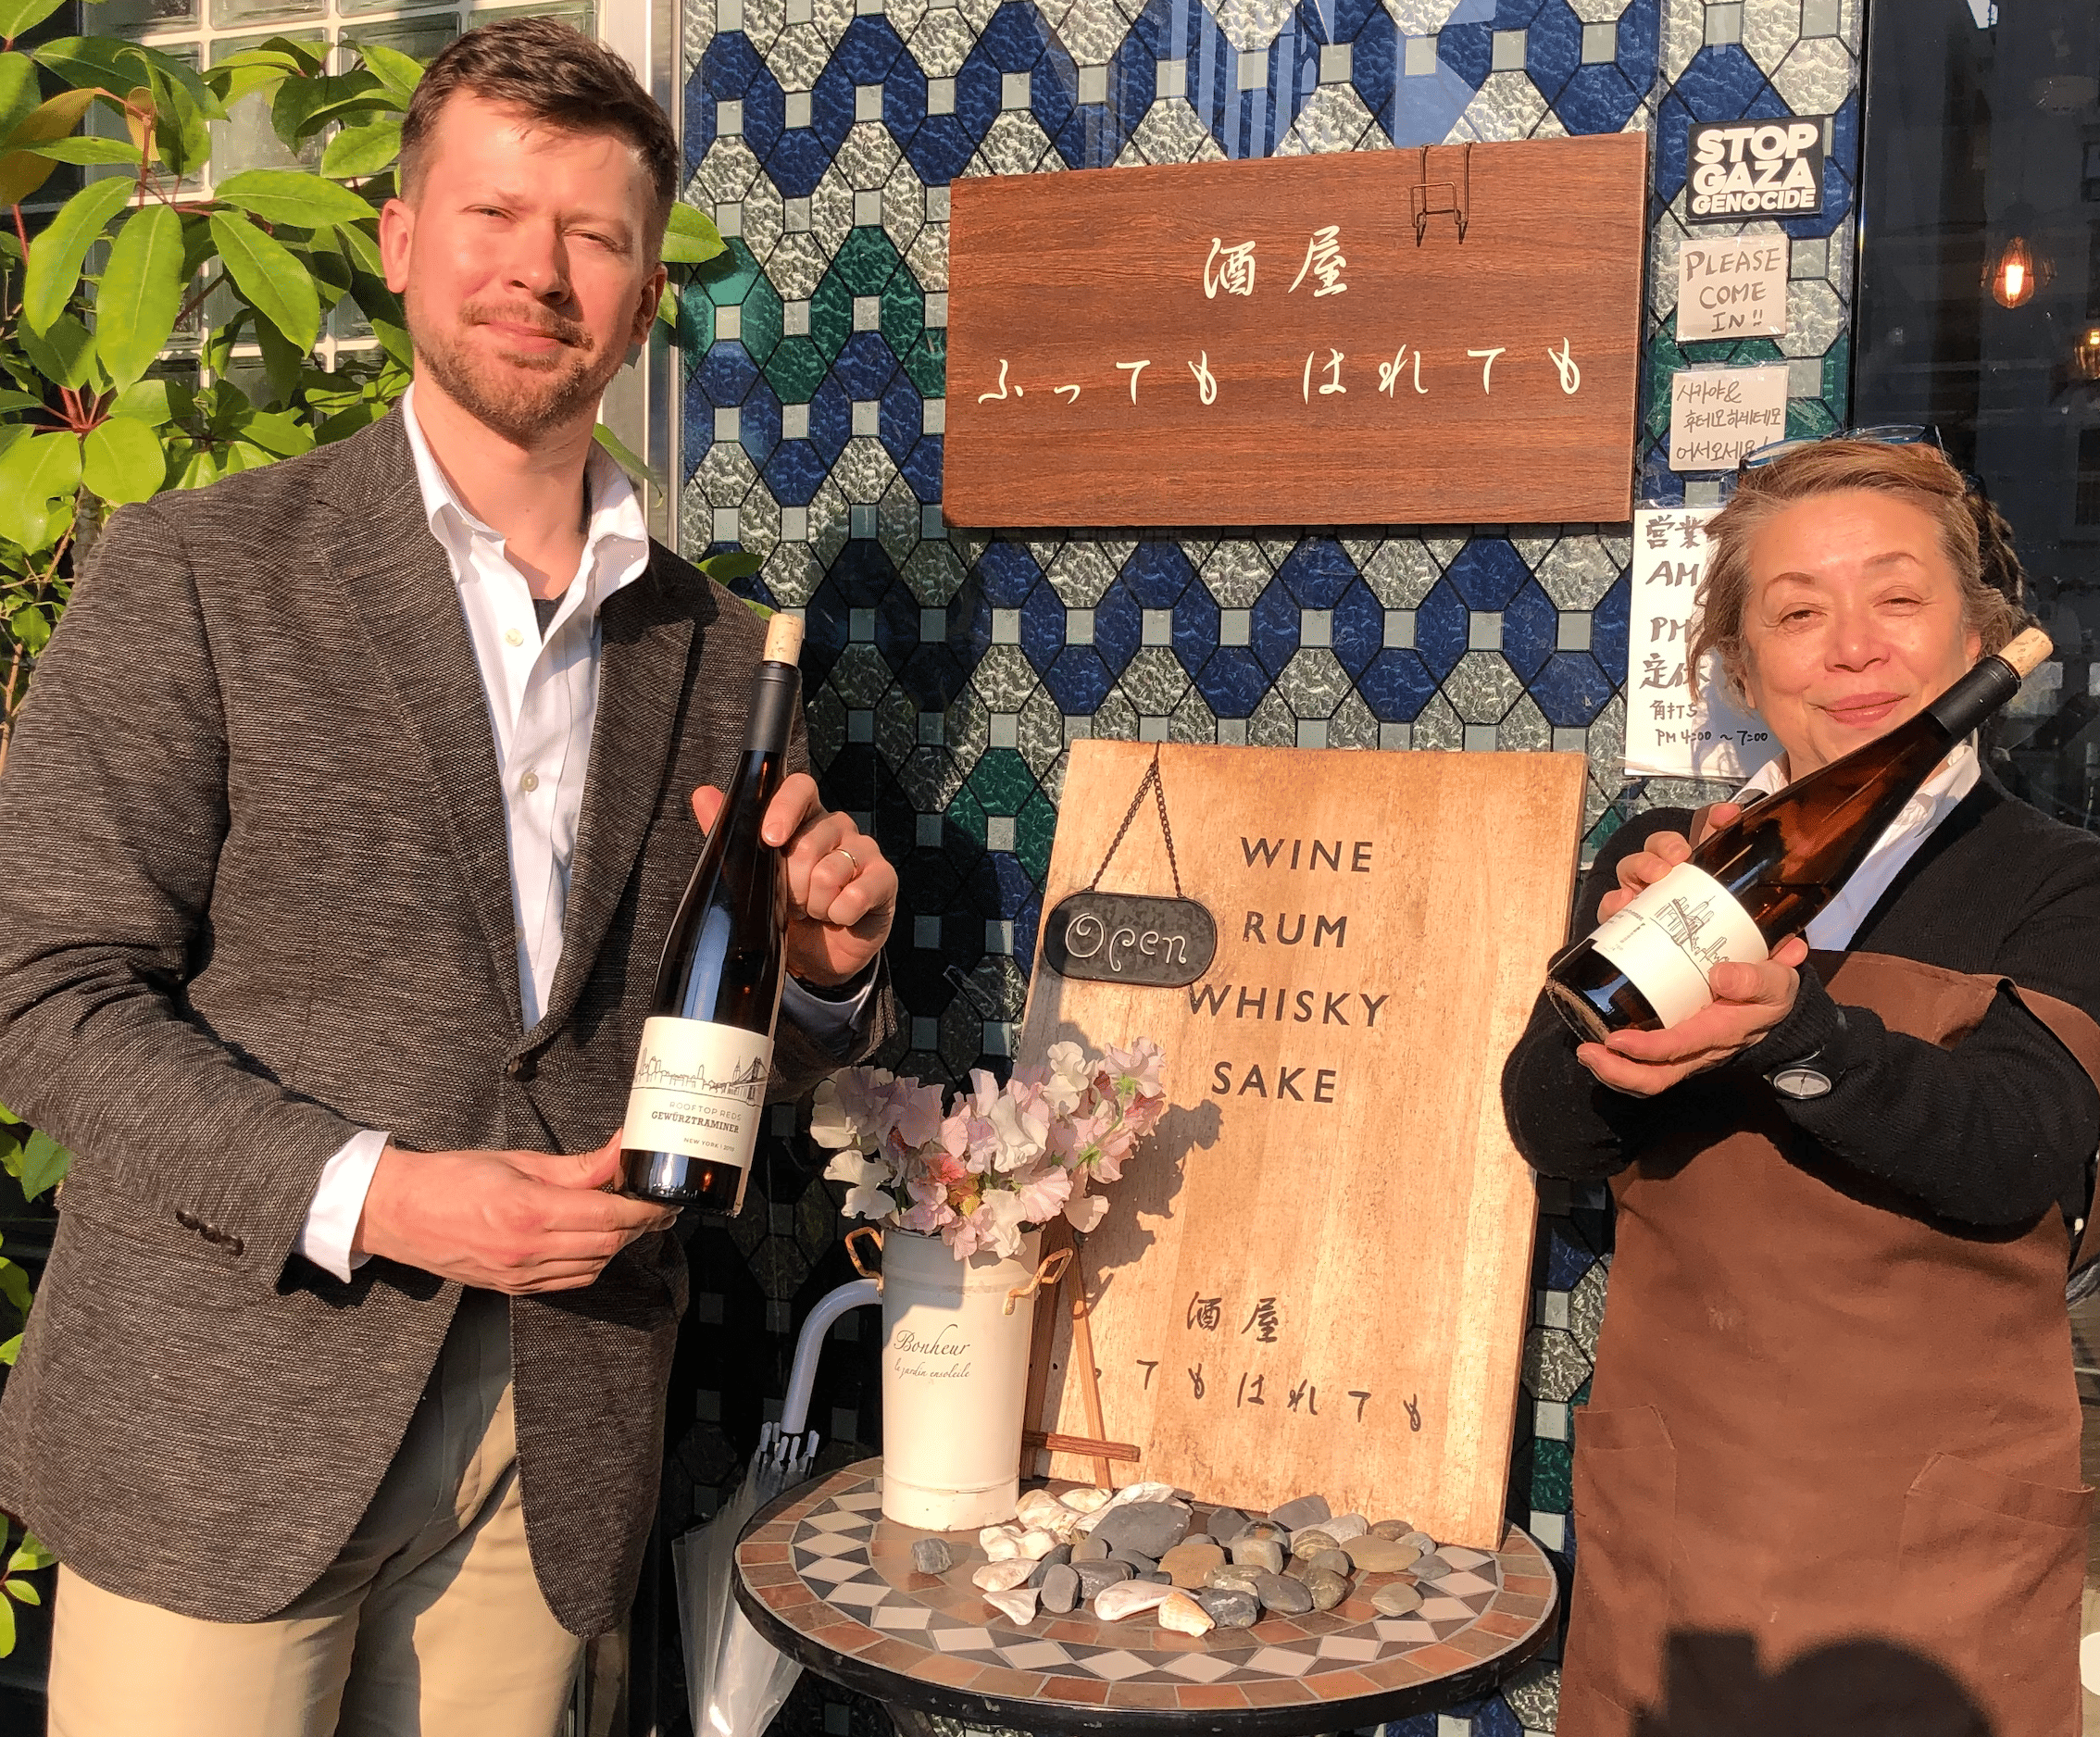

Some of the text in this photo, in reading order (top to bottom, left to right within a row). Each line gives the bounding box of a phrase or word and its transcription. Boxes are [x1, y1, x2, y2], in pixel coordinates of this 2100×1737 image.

[1694, 123, 1819, 164] STOP
[1693, 157, 1816, 195] GAZA
[1692, 189, 1816, 215] GENOCIDE
[1205, 225, 1348, 299] 酒屋
[1684, 247, 1781, 281] PLEASE
[1699, 281, 1766, 309] COME
[1645, 514, 1705, 549] 営業
[1645, 560, 1700, 587] AM
[1650, 617, 1693, 643] PM
[1655, 729, 1677, 746] PM
[1681, 729, 1712, 744] 4:00
[1736, 730, 1769, 746] 7:00
[1241, 837, 1373, 873] WINE
[1065, 913, 1187, 972] Open
[1243, 911, 1348, 948] RUM
[1189, 983, 1390, 1027] WHISKY
[1212, 1061, 1337, 1104] SAKE
[651, 1110, 740, 1134] GEWÜRZTRAMINER
[669, 1101, 742, 1121] ROOFTOP REDS
[683, 1137, 701, 1145] NEW
[701, 1140, 719, 1149] YORK
[1187, 1291, 1279, 1343] 酒屋
[894, 1323, 970, 1356] Bonheur
[894, 1357, 903, 1371] le
[899, 1361, 927, 1380] jardin
